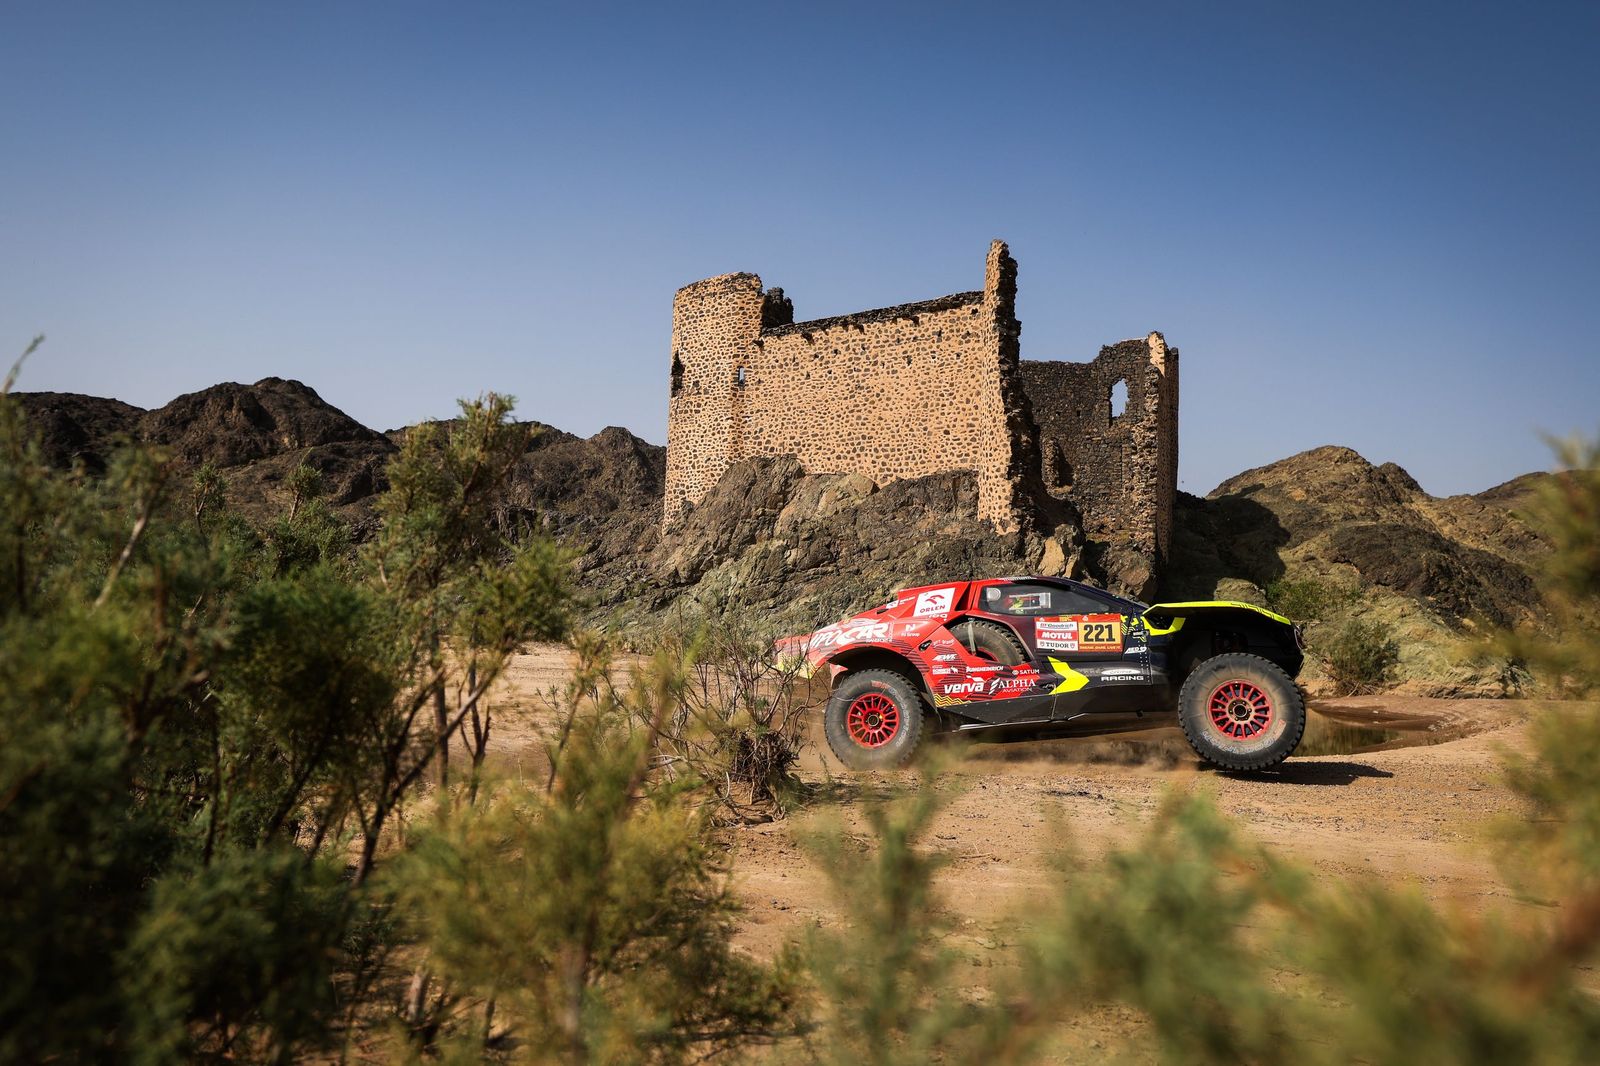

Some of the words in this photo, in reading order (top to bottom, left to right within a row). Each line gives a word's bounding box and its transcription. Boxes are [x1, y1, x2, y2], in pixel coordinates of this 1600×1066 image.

[920, 605, 946, 613] ORLEN
[1041, 631, 1073, 640] MOTUL
[1083, 624, 1116, 642] 221
[1046, 641, 1070, 649] TUDOR
[944, 682, 984, 694] verva
[999, 679, 1036, 688] ALPHA
